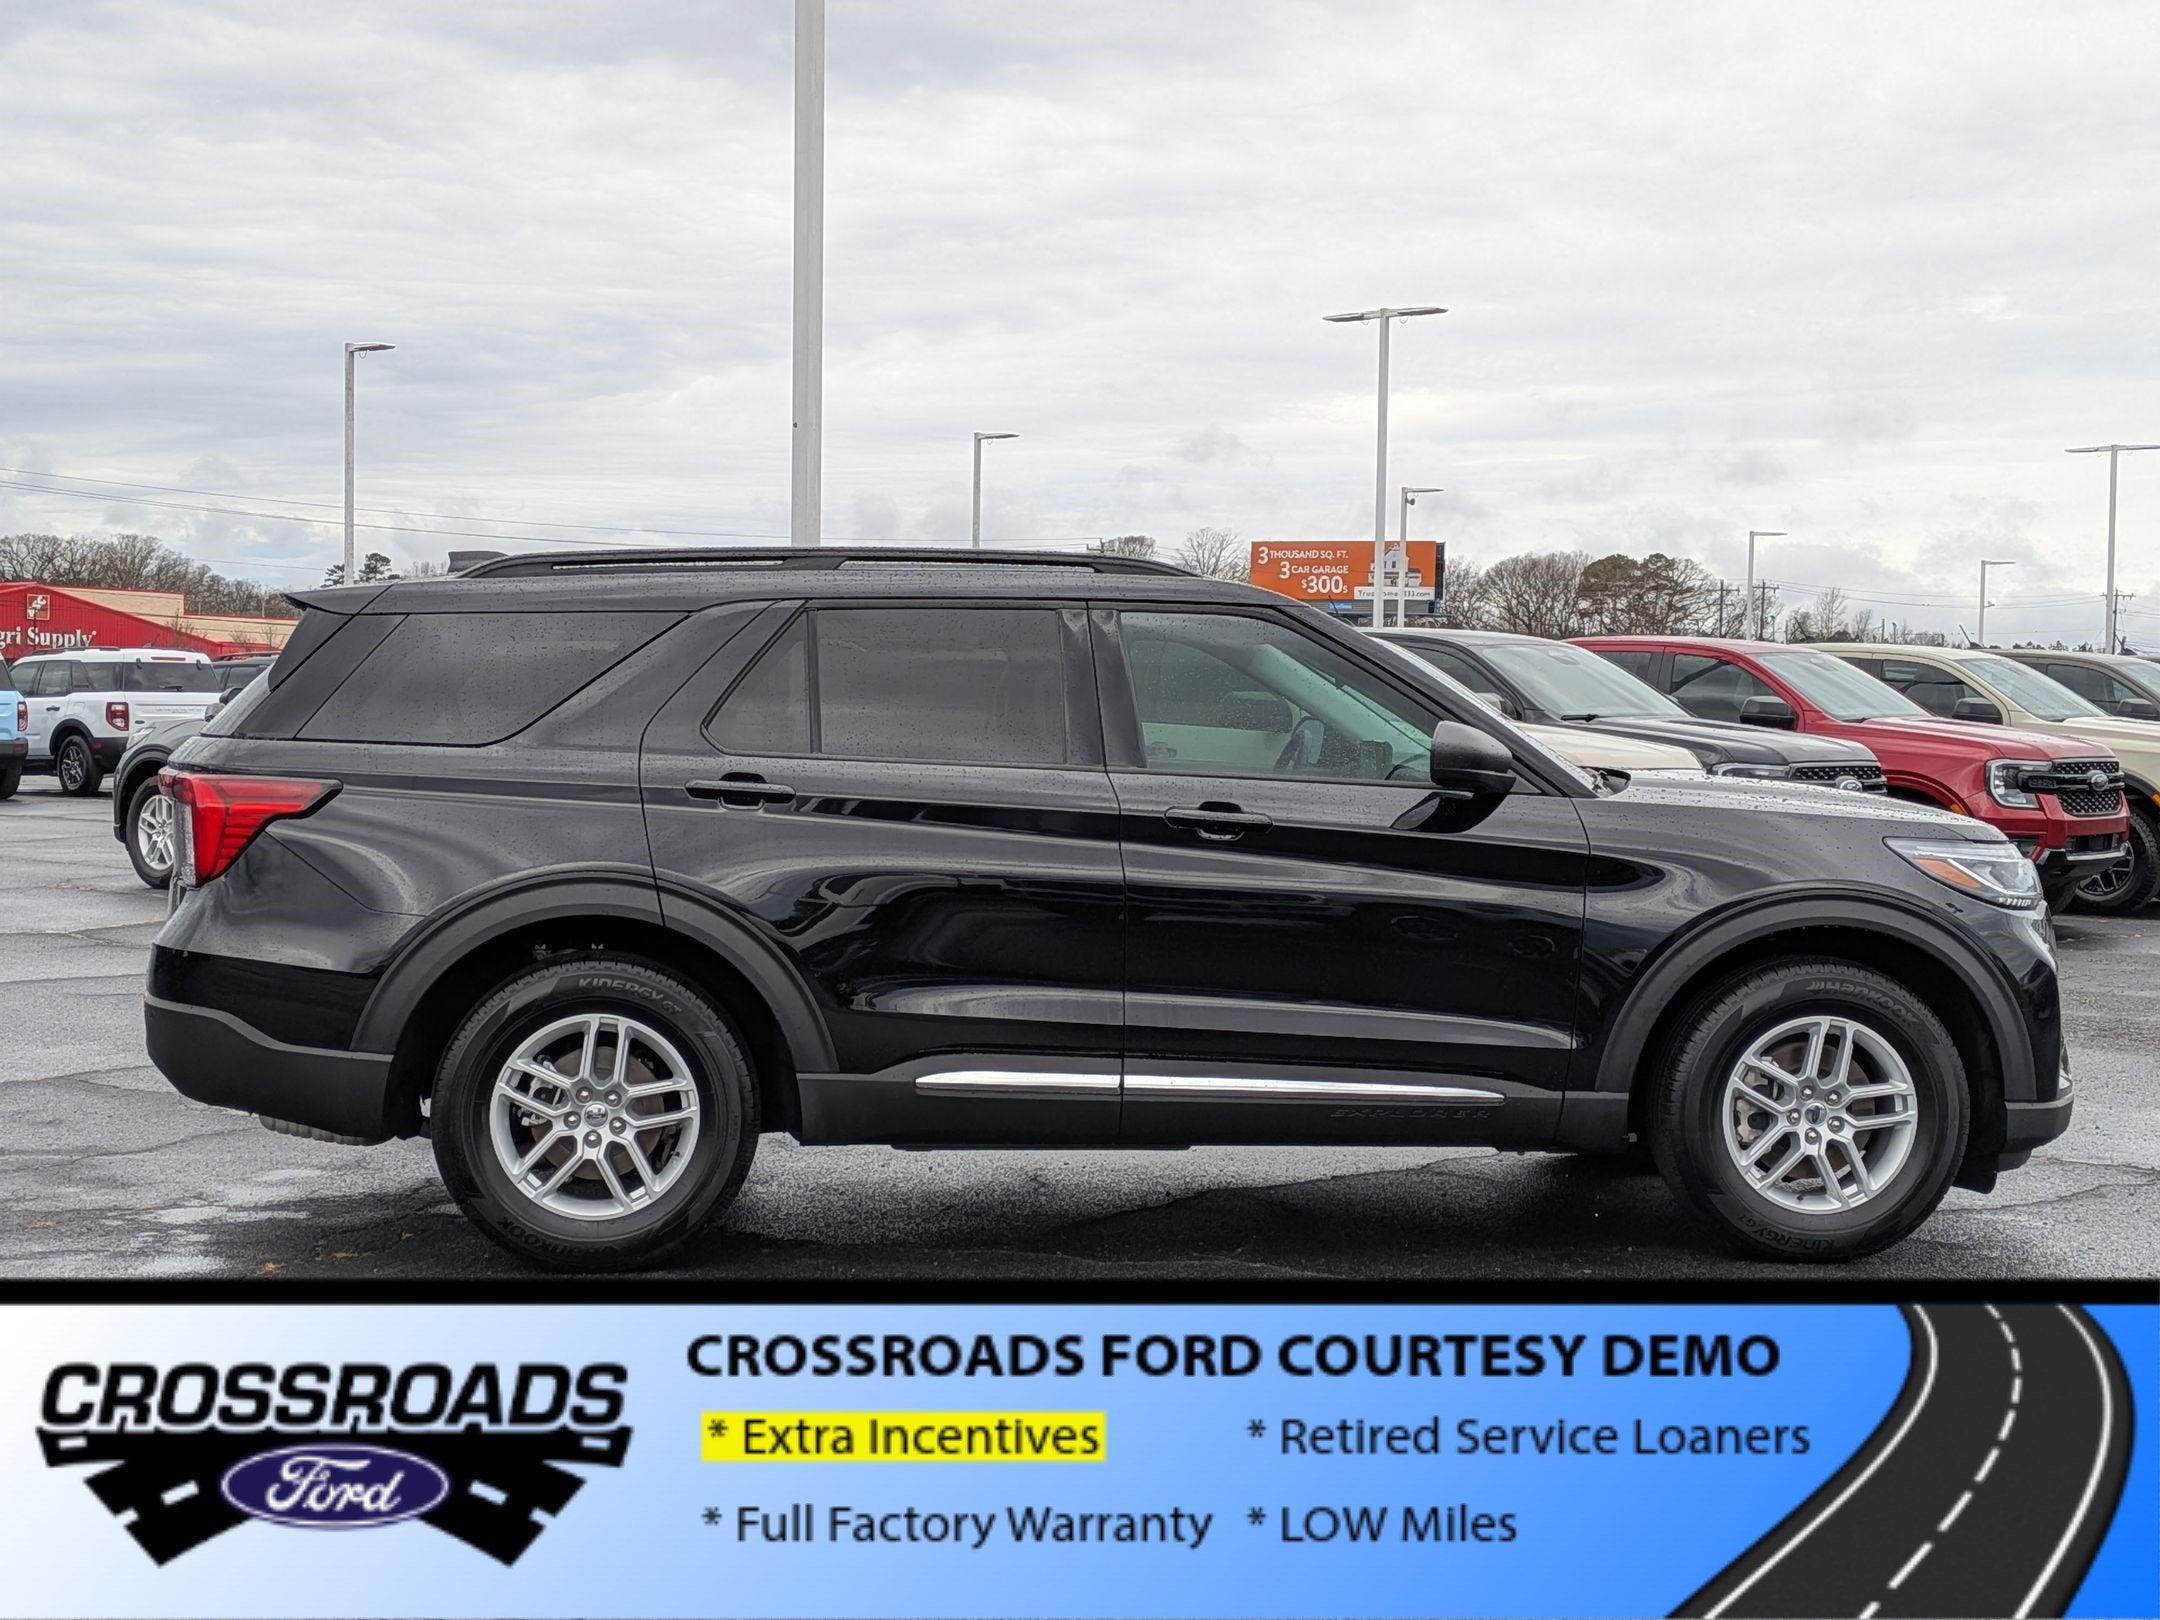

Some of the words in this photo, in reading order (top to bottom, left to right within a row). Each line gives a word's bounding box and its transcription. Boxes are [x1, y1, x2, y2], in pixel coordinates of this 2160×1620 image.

[1258, 546, 1269, 564] 3
[1269, 550, 1319, 559] THOUSAND
[1320, 550, 1335, 560] SQ.
[1336, 550, 1349, 559] FT.
[1279, 561, 1290, 579] 3
[1291, 565, 1310, 574] CAR
[1311, 565, 1349, 574] GARAGE
[27, 626, 93, 649] Supply
[1329, 1108, 1490, 1120] EXPLORER
